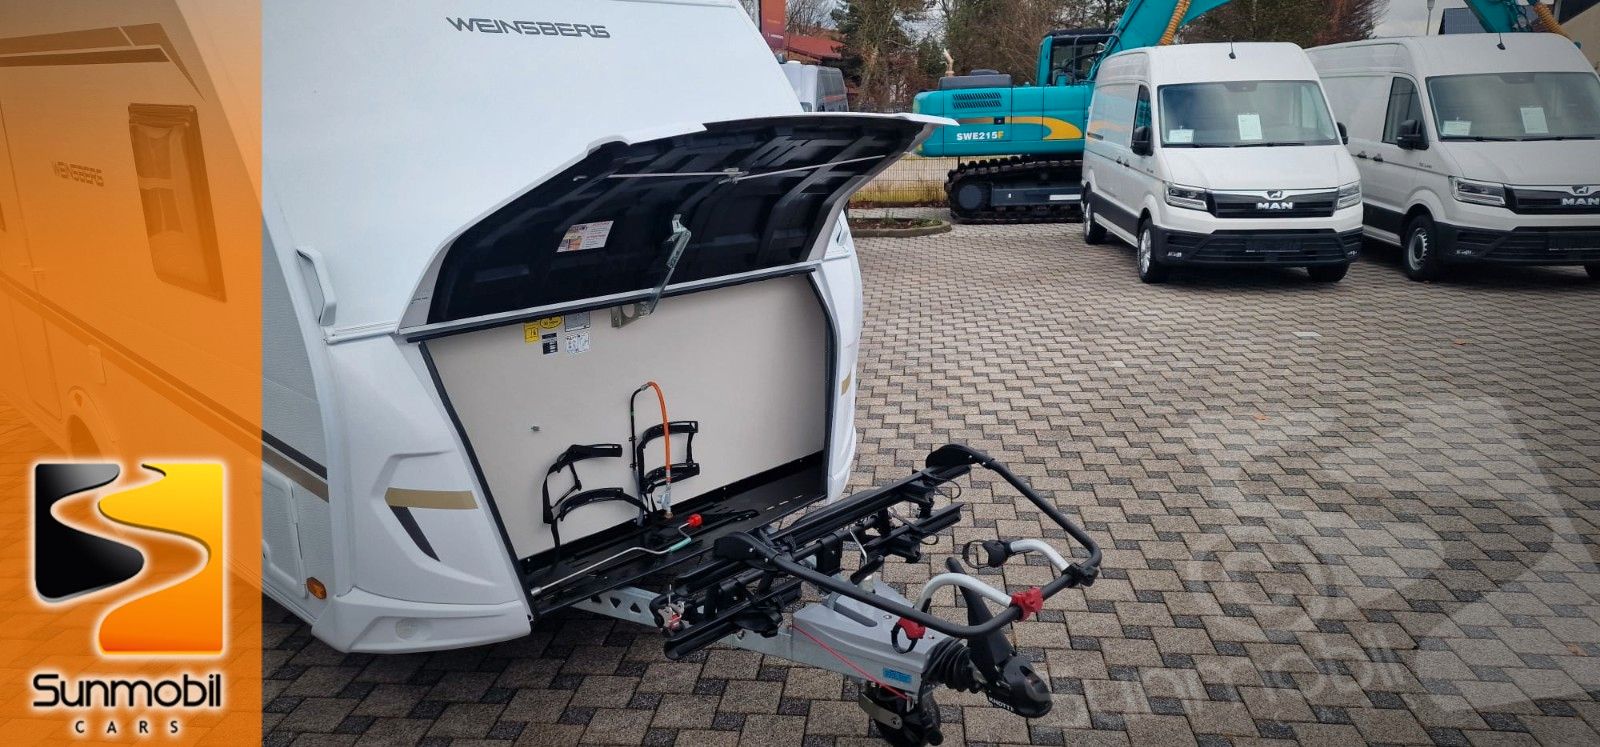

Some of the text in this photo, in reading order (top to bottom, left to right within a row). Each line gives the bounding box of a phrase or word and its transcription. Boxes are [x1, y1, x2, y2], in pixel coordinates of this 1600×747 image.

[445, 16, 611, 39] WEINSBERG
[956, 130, 1004, 141] SWE215F
[1256, 201, 1294, 210] MAN
[1562, 197, 1600, 206] MAN
